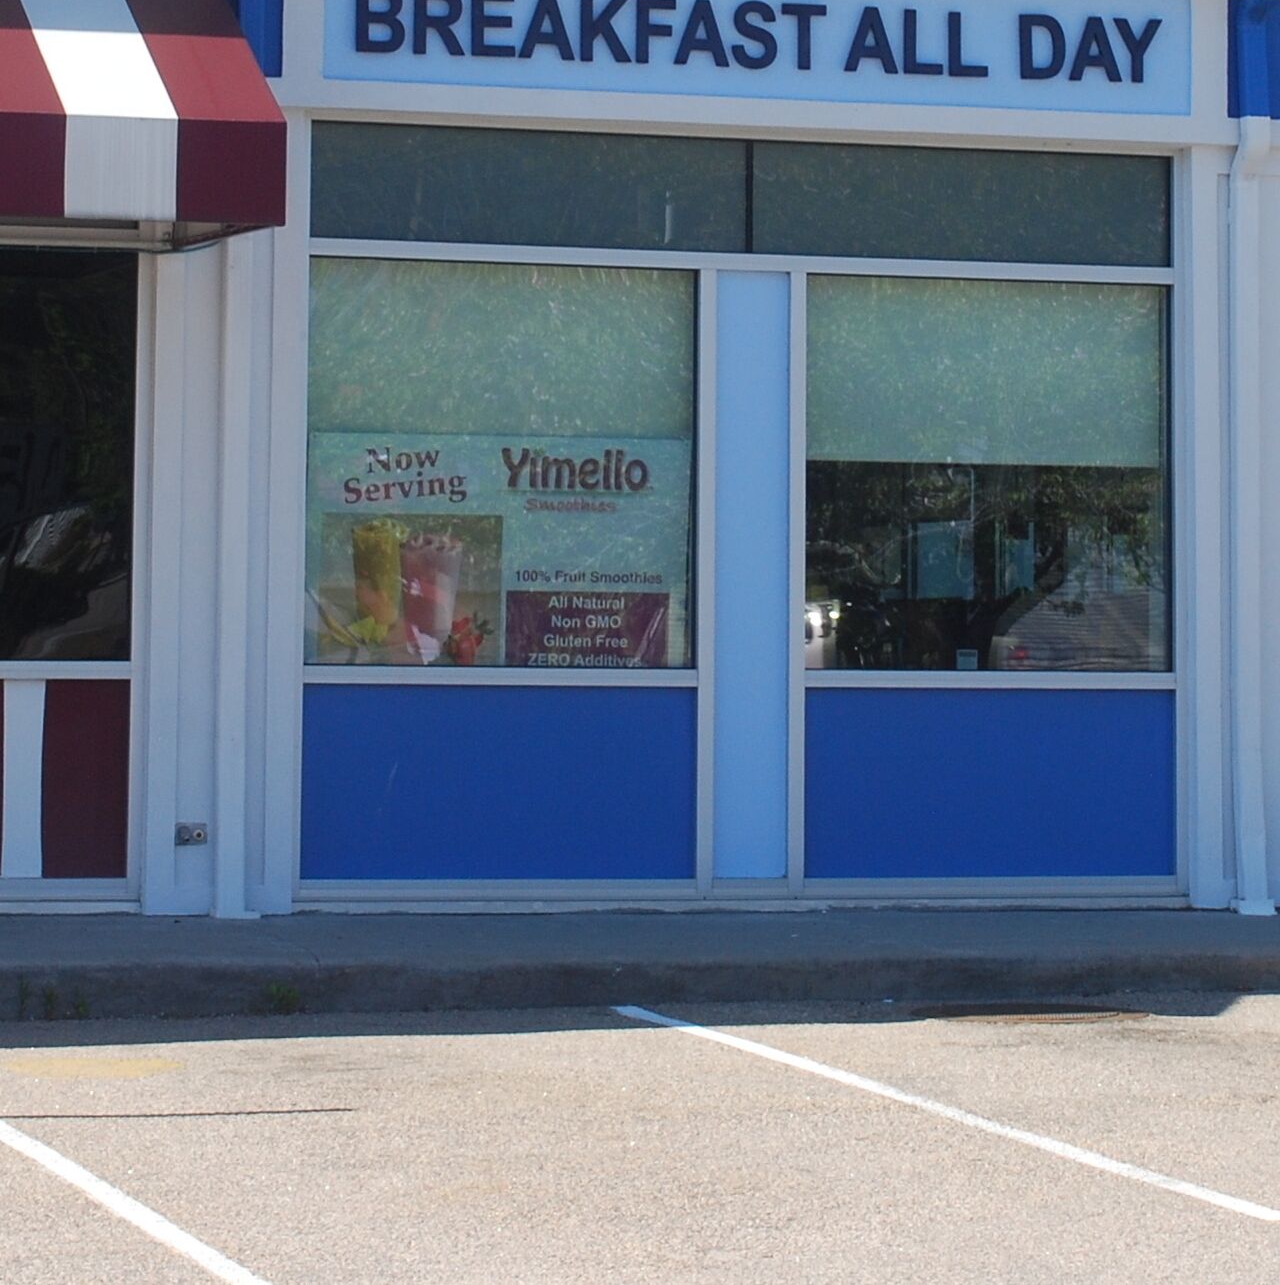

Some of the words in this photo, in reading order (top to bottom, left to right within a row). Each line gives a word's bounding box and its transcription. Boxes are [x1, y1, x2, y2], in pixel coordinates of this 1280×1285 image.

[844, 6, 988, 78] ALL
[1018, 13, 1162, 84] DAY
[366, 446, 440, 473] Now
[501, 447, 649, 491] Yimello
[343, 471, 468, 504] Serving
[515, 570, 551, 583] 100%
[554, 570, 587, 583] Fruit
[590, 571, 663, 585] Smoothies
[548, 596, 568, 609] All
[572, 597, 625, 610] Natural
[551, 615, 580, 628] Non
[585, 615, 622, 629] GMO
[543, 634, 592, 648] Gluten
[595, 634, 629, 648] Free
[528, 653, 570, 667] ZERO
